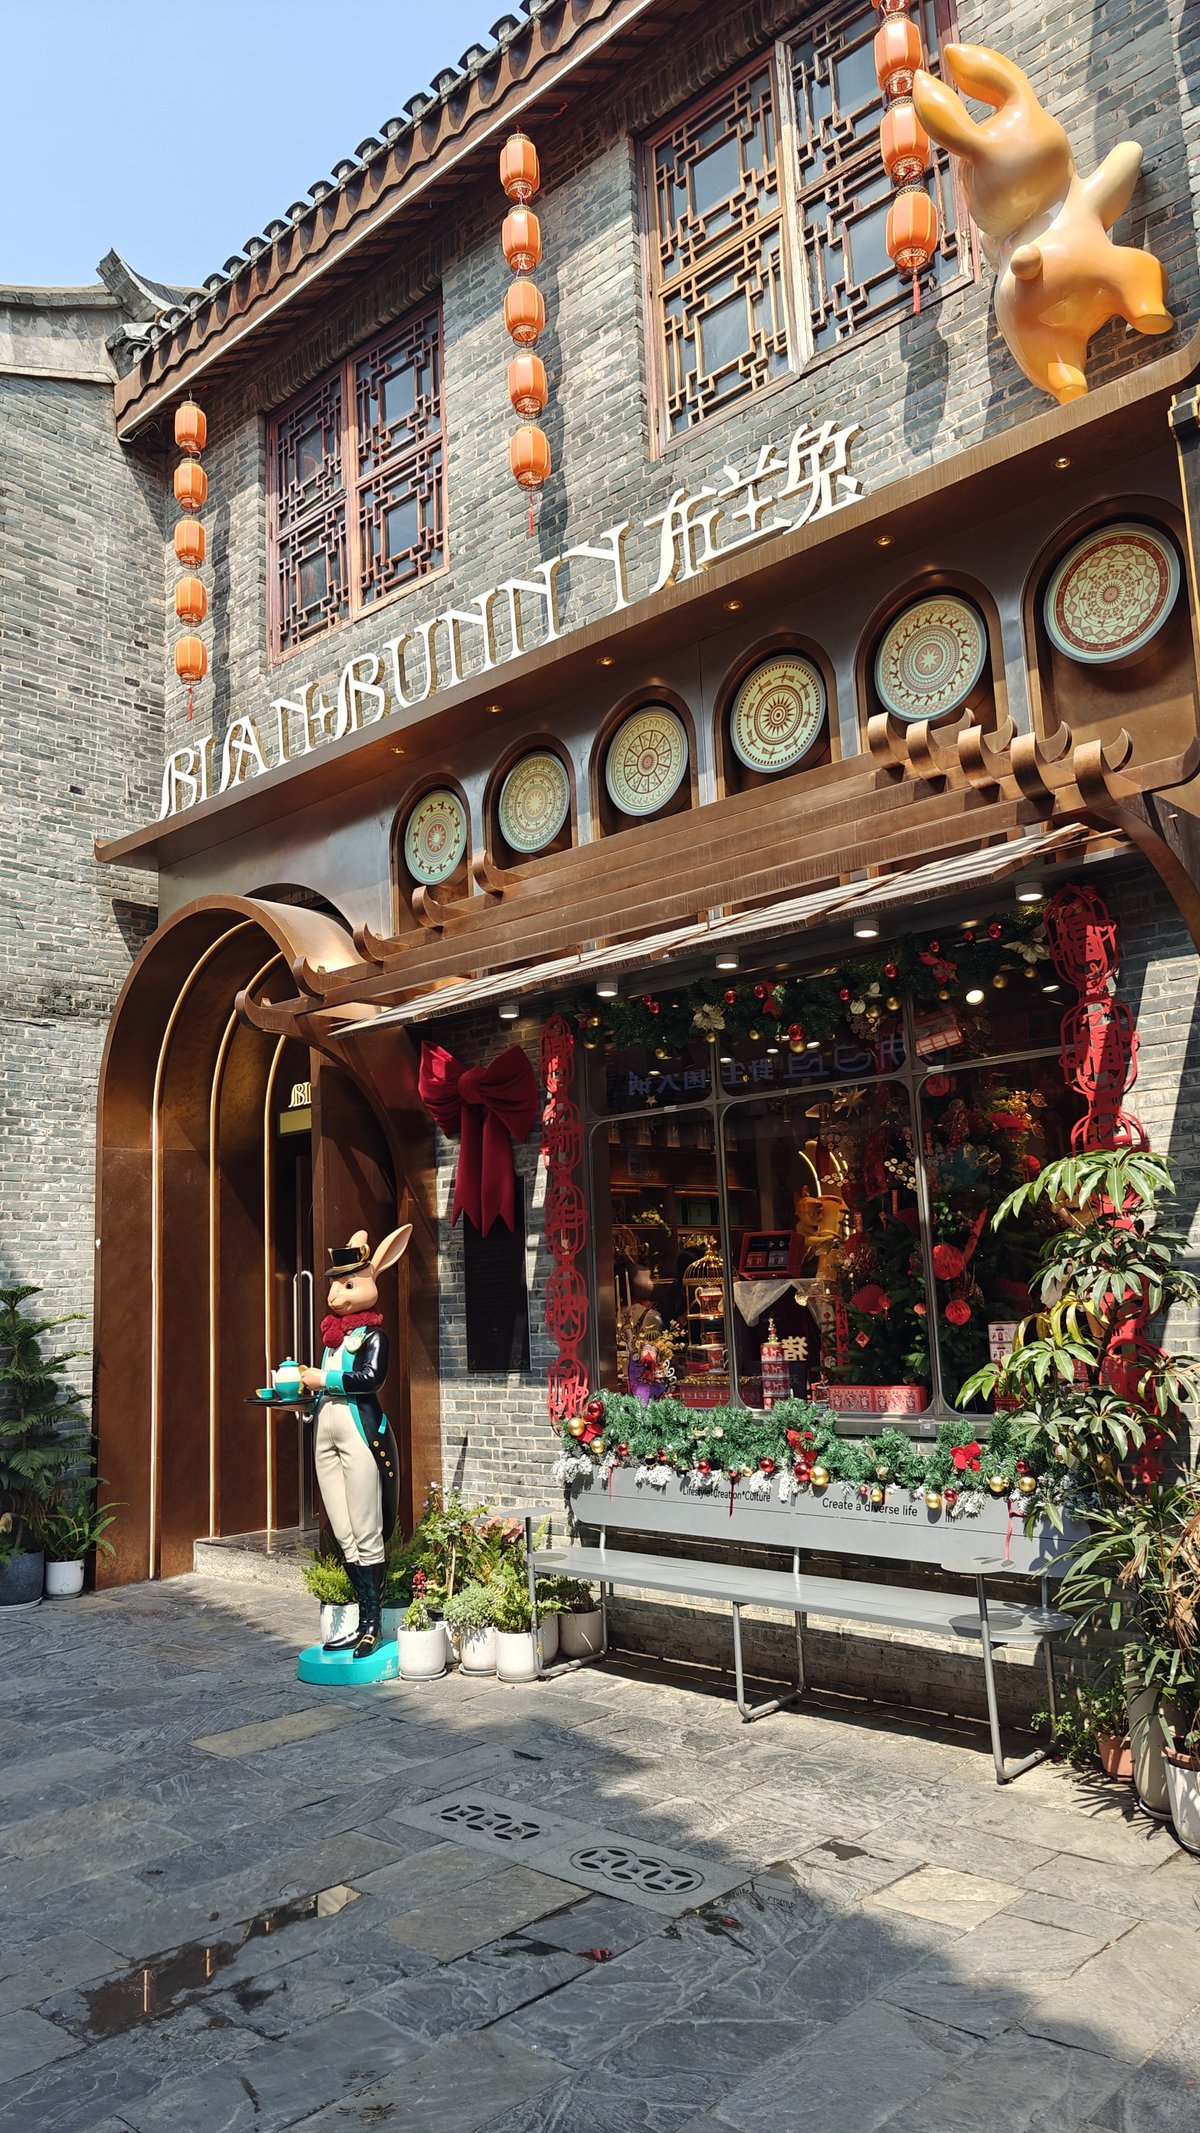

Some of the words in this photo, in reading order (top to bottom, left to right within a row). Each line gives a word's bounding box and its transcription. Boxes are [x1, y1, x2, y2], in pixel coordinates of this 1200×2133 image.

[822, 1497, 854, 1510] Create
[855, 1503, 861, 1511] a
[864, 1501, 899, 1515] diverse
[902, 1505, 918, 1517] life
